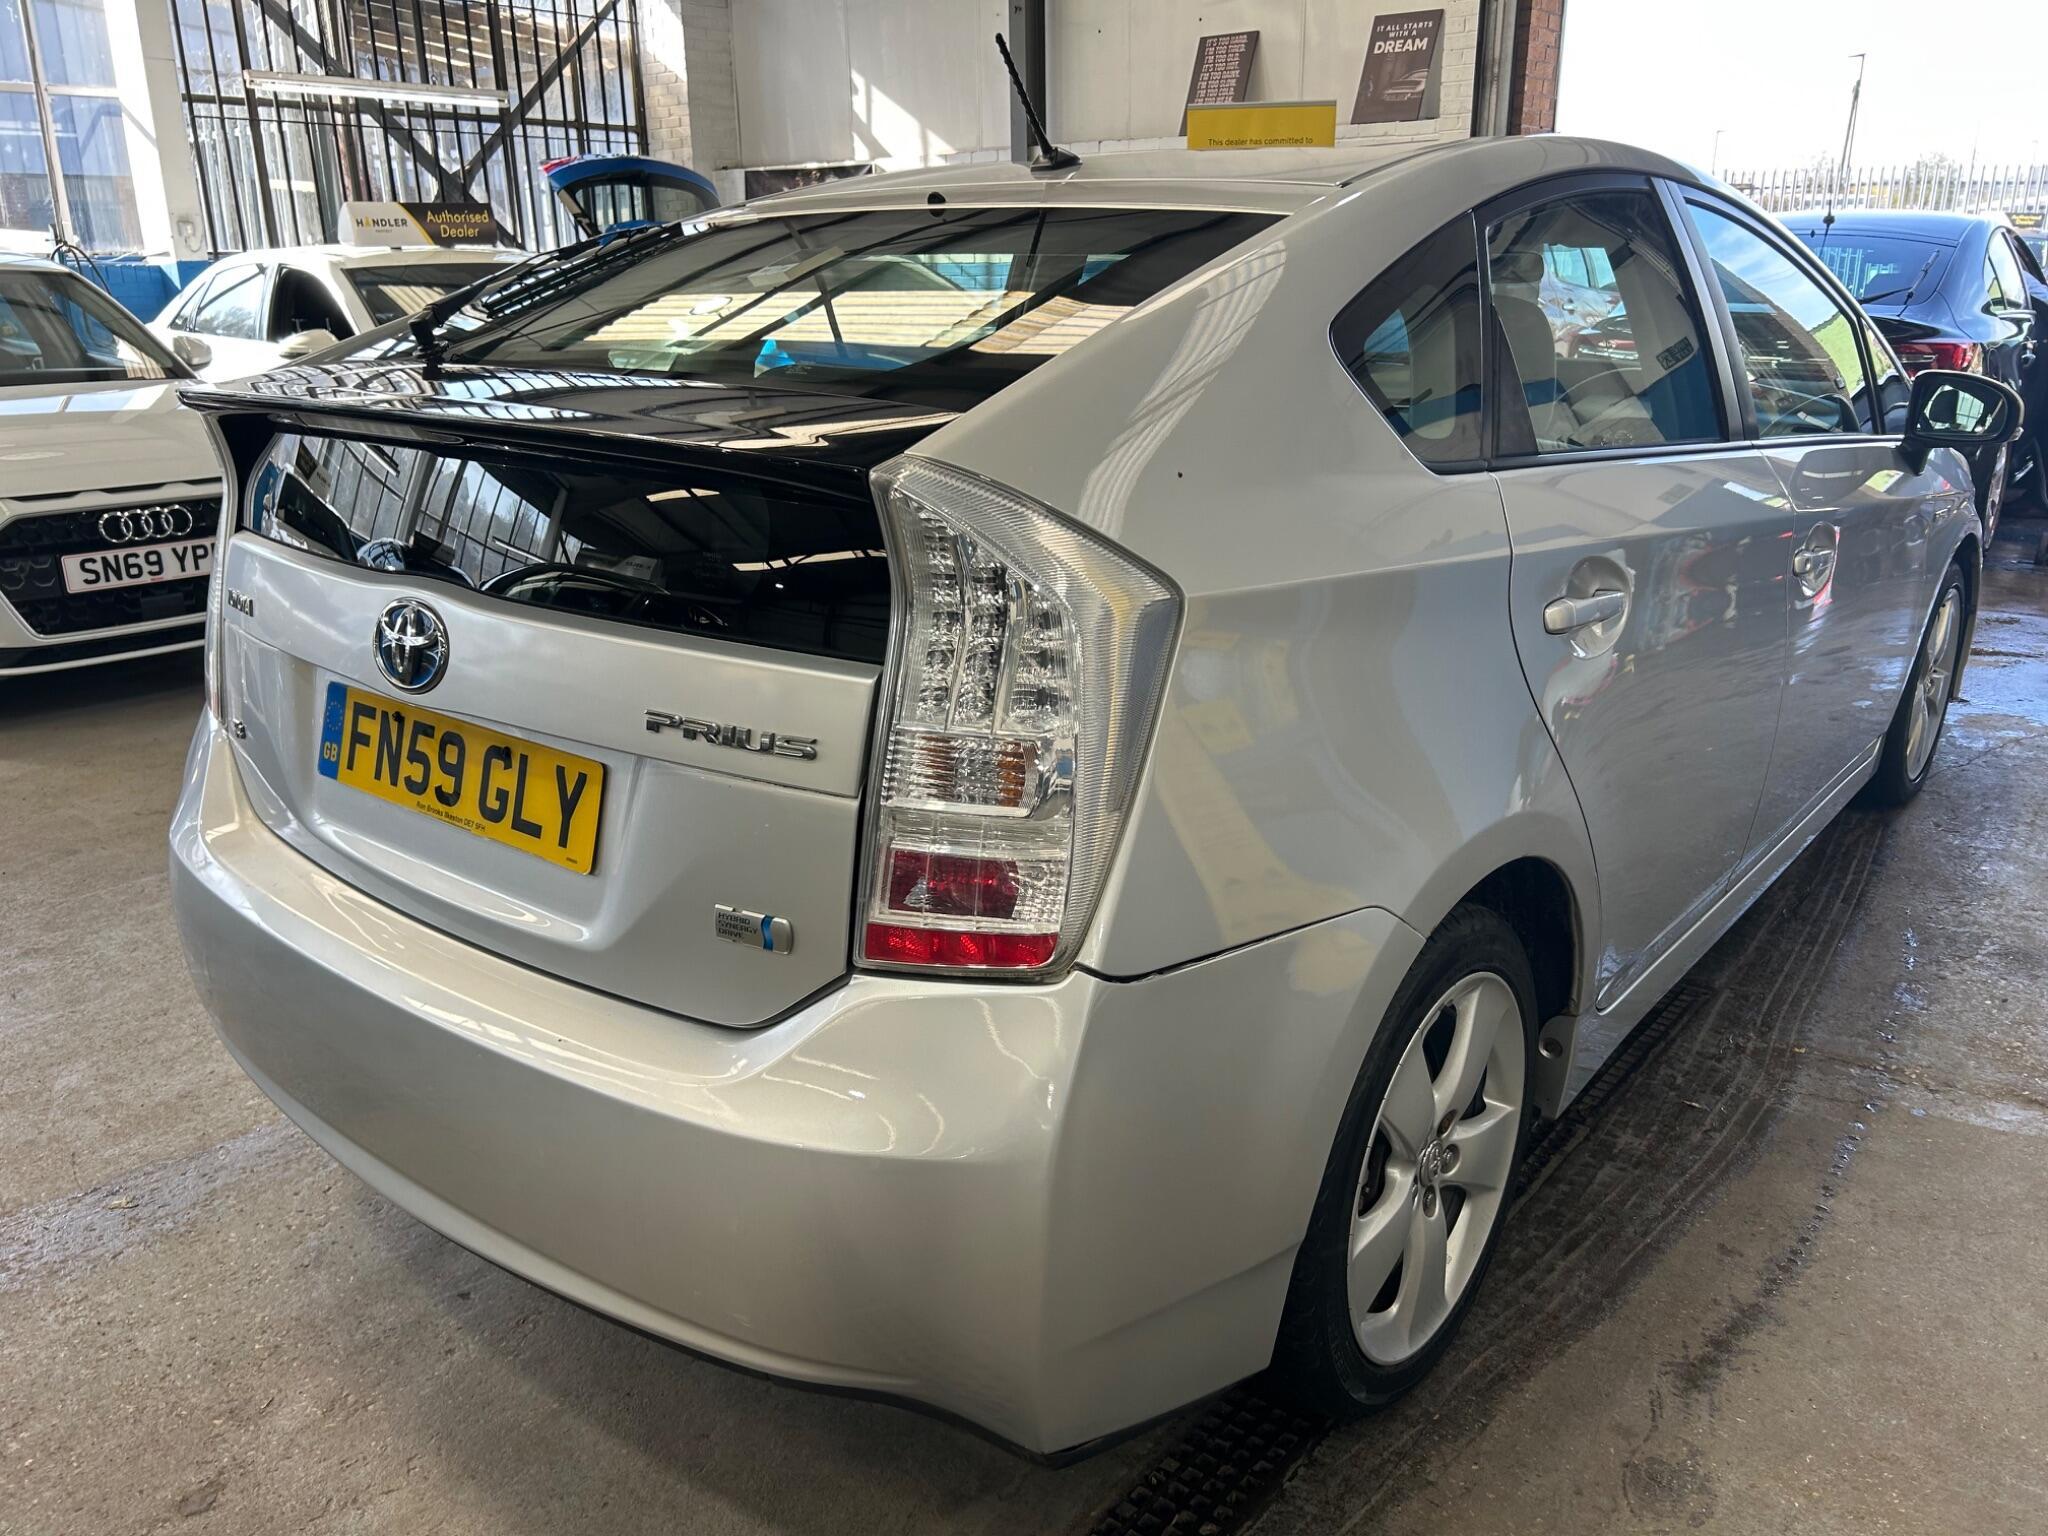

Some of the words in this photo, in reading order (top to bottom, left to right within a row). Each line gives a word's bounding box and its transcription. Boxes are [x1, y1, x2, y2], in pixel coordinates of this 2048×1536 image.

[1403, 21, 1433, 30] STARTS
[1389, 30, 1408, 38] WITH
[1218, 37, 1230, 46] TOO
[1373, 37, 1429, 54] DREAM
[1216, 46, 1227, 54] TOO
[1215, 54, 1227, 63] TOO
[1215, 63, 1226, 71] TOO
[1210, 71, 1221, 80] TOO
[1208, 80, 1219, 88] TOO
[1207, 88, 1218, 97] TOO
[1208, 138, 1223, 146] This
[1224, 137, 1249, 146] dealer
[1264, 137, 1305, 145] committed
[427, 209, 489, 223] Authorised
[440, 225, 479, 238] Dealer
[79, 549, 164, 585] SN69
[643, 708, 818, 761] PRIUS
[323, 741, 338, 762] GB
[346, 701, 466, 808] FN59
[478, 743, 588, 849] GLY
[718, 912, 750, 925] HYBRID
[718, 920, 758, 934] SYNERGY
[718, 927, 744, 938] DRIVE
